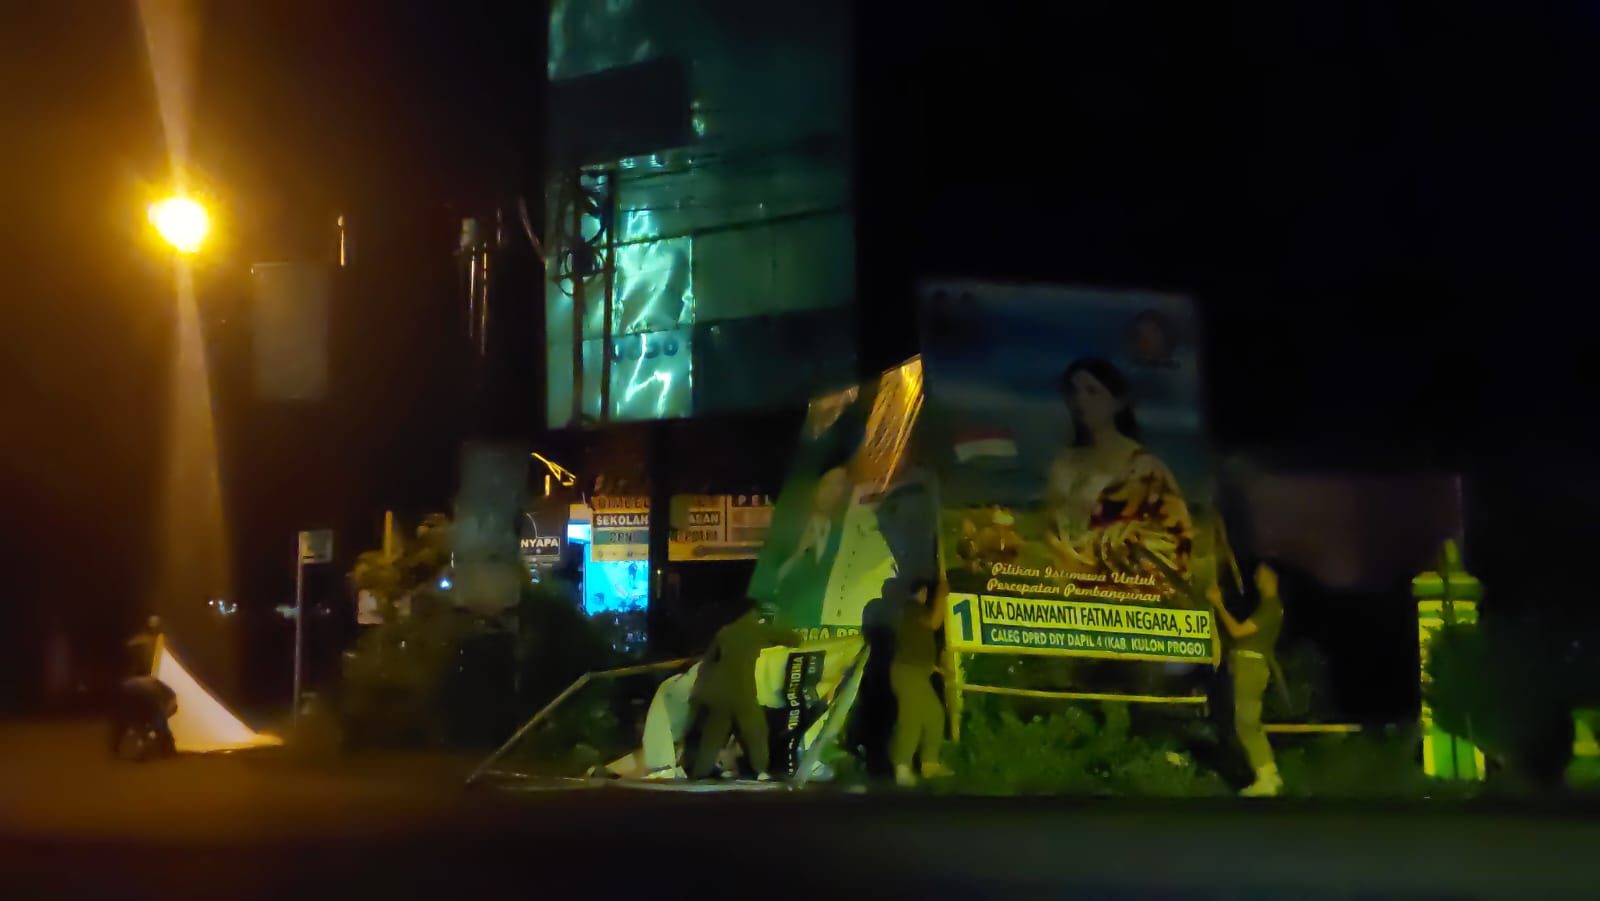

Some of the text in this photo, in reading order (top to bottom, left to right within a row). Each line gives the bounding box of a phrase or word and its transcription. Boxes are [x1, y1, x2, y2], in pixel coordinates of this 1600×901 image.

[596, 514, 649, 526] SEKOLAH
[986, 578, 1162, 603] Percepatan Pembangunan
[1111, 571, 1157, 586] Untuk
[952, 599, 974, 641] 1
[984, 600, 1004, 620] IKA
[1006, 602, 1078, 625] DAMAYANTI
[1080, 606, 1123, 628] FATMA
[1125, 610, 1181, 635] NEGARA,
[990, 628, 1020, 644] CALEG
[1022, 631, 1047, 645] DPRD
[1049, 633, 1065, 646] DIY
[1067, 634, 1095, 648] DAPIL
[1131, 638, 1165, 652] KULON
[1167, 641, 1206, 656] PROGO)
